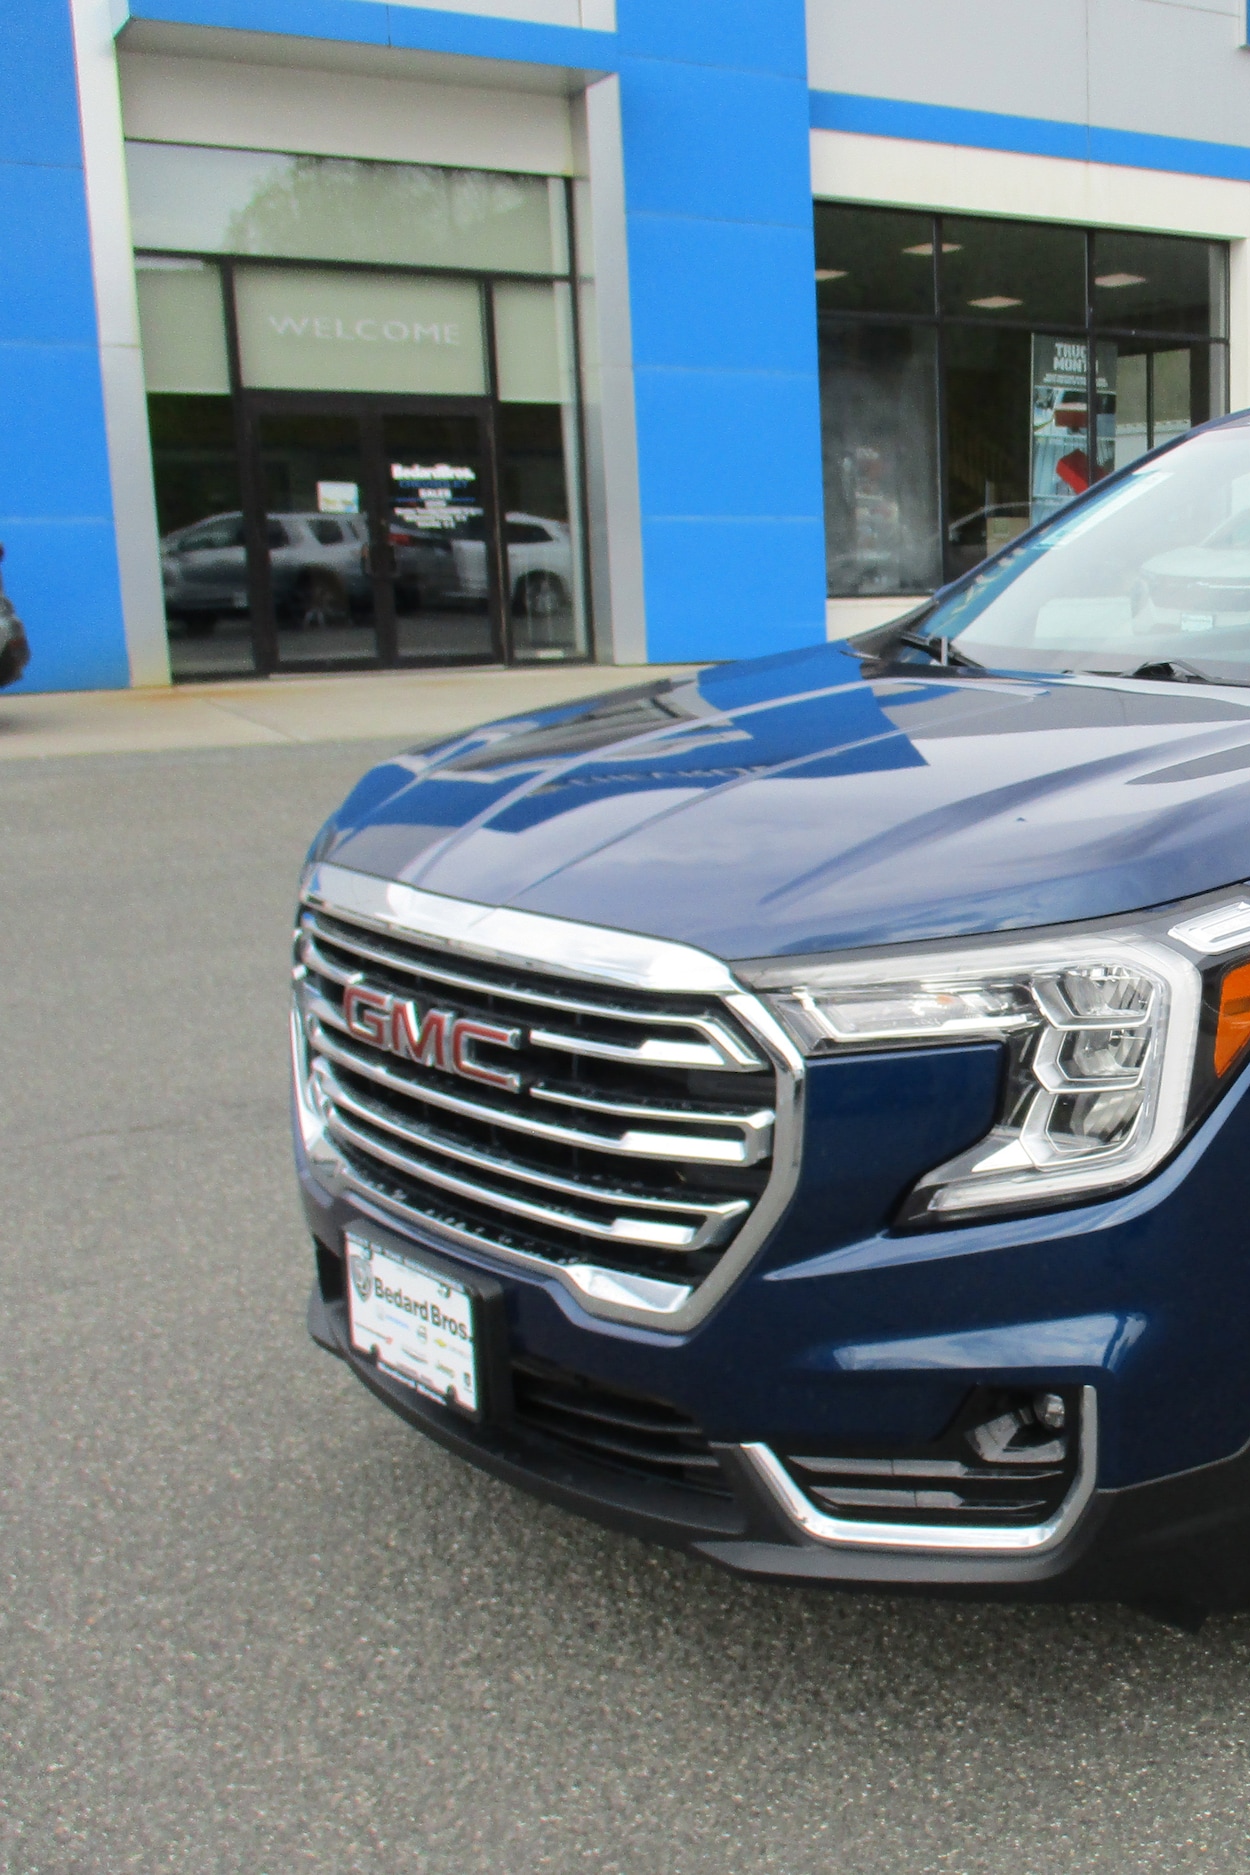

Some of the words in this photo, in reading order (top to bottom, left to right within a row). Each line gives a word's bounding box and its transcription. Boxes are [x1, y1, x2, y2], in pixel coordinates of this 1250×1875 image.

[268, 314, 461, 346] WELCOME
[1055, 342, 1088, 358] TRUC
[343, 983, 521, 1094] GMC
[374, 1276, 430, 1323] Bedard
